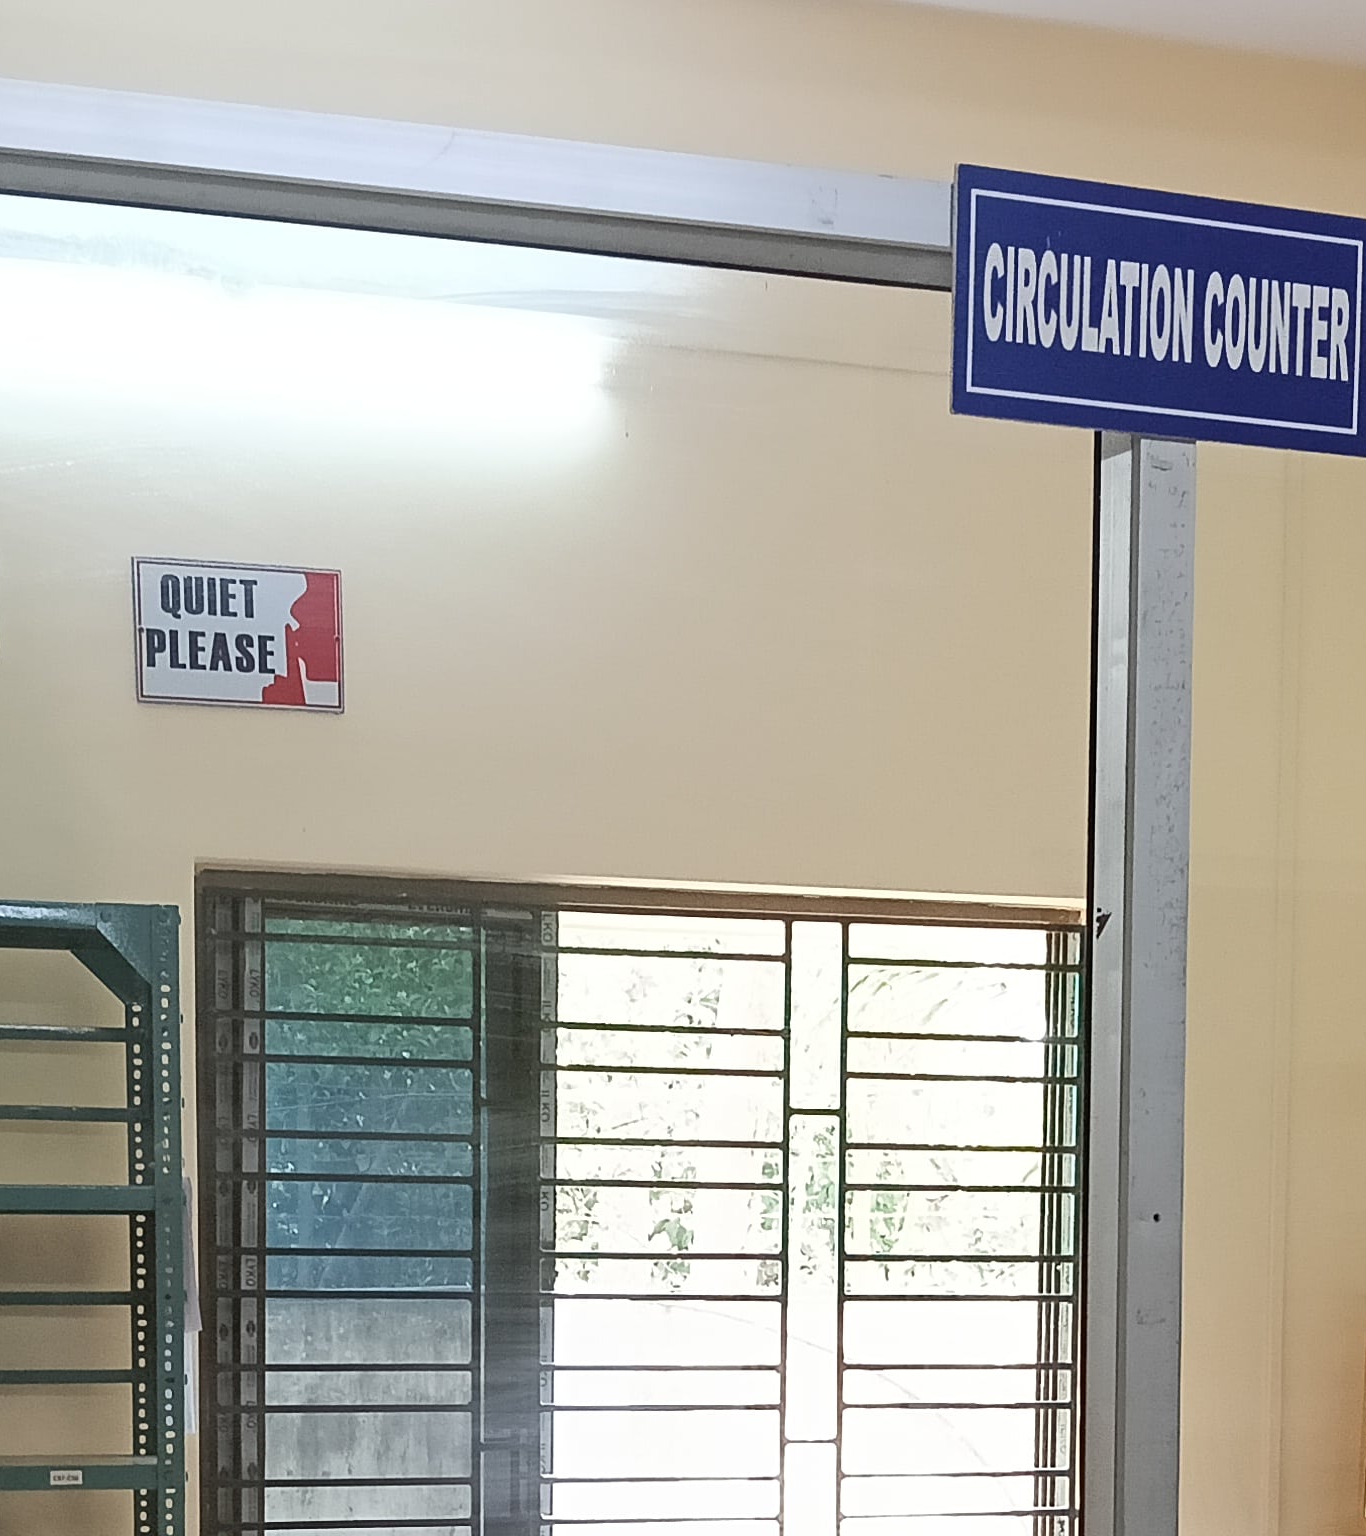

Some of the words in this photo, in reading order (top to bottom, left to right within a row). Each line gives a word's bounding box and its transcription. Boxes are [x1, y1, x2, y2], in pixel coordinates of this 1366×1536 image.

[983, 241, 1195, 364] CIRCULATION
[1204, 271, 1350, 382] COUNTER
[160, 573, 257, 620] QUIET
[145, 627, 277, 675] PLEASE
[248, 968, 261, 999] LYKO
[244, 1258, 257, 1287] LYKO
